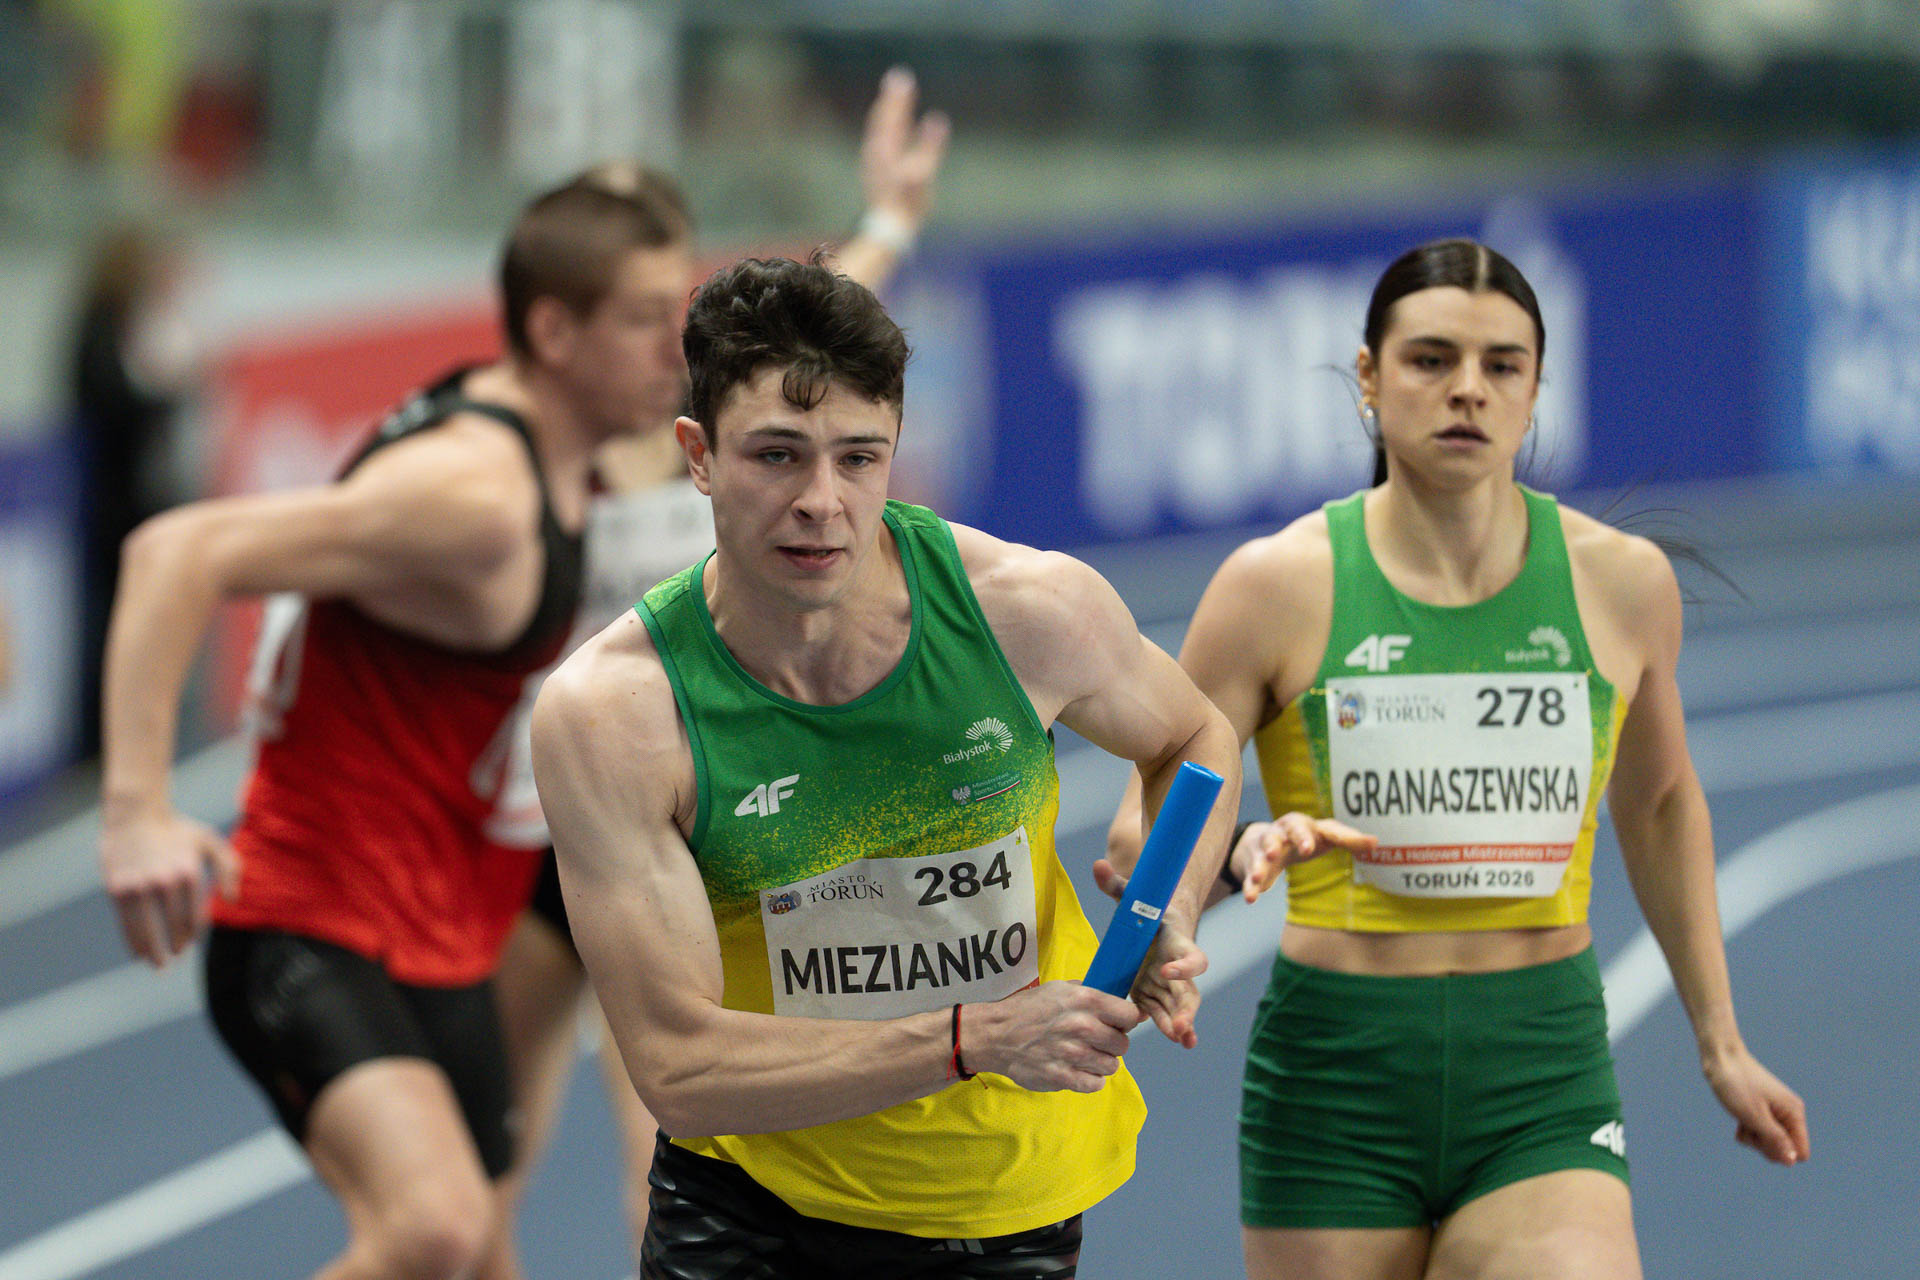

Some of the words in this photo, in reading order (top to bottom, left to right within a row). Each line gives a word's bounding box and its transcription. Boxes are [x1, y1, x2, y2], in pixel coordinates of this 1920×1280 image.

[1344, 634, 1412, 672] 4F
[1476, 687, 1566, 727] 278
[734, 774, 800, 818] 4F
[1342, 766, 1579, 817] GRANASZEWSKA
[807, 881, 885, 903] TORUŃ
[810, 875, 866, 892] MIASTO
[914, 850, 1012, 906] 284
[1402, 866, 1479, 888] TORUŃ
[1486, 870, 1534, 888] 2026
[780, 921, 1027, 996] MIEZIANKO
